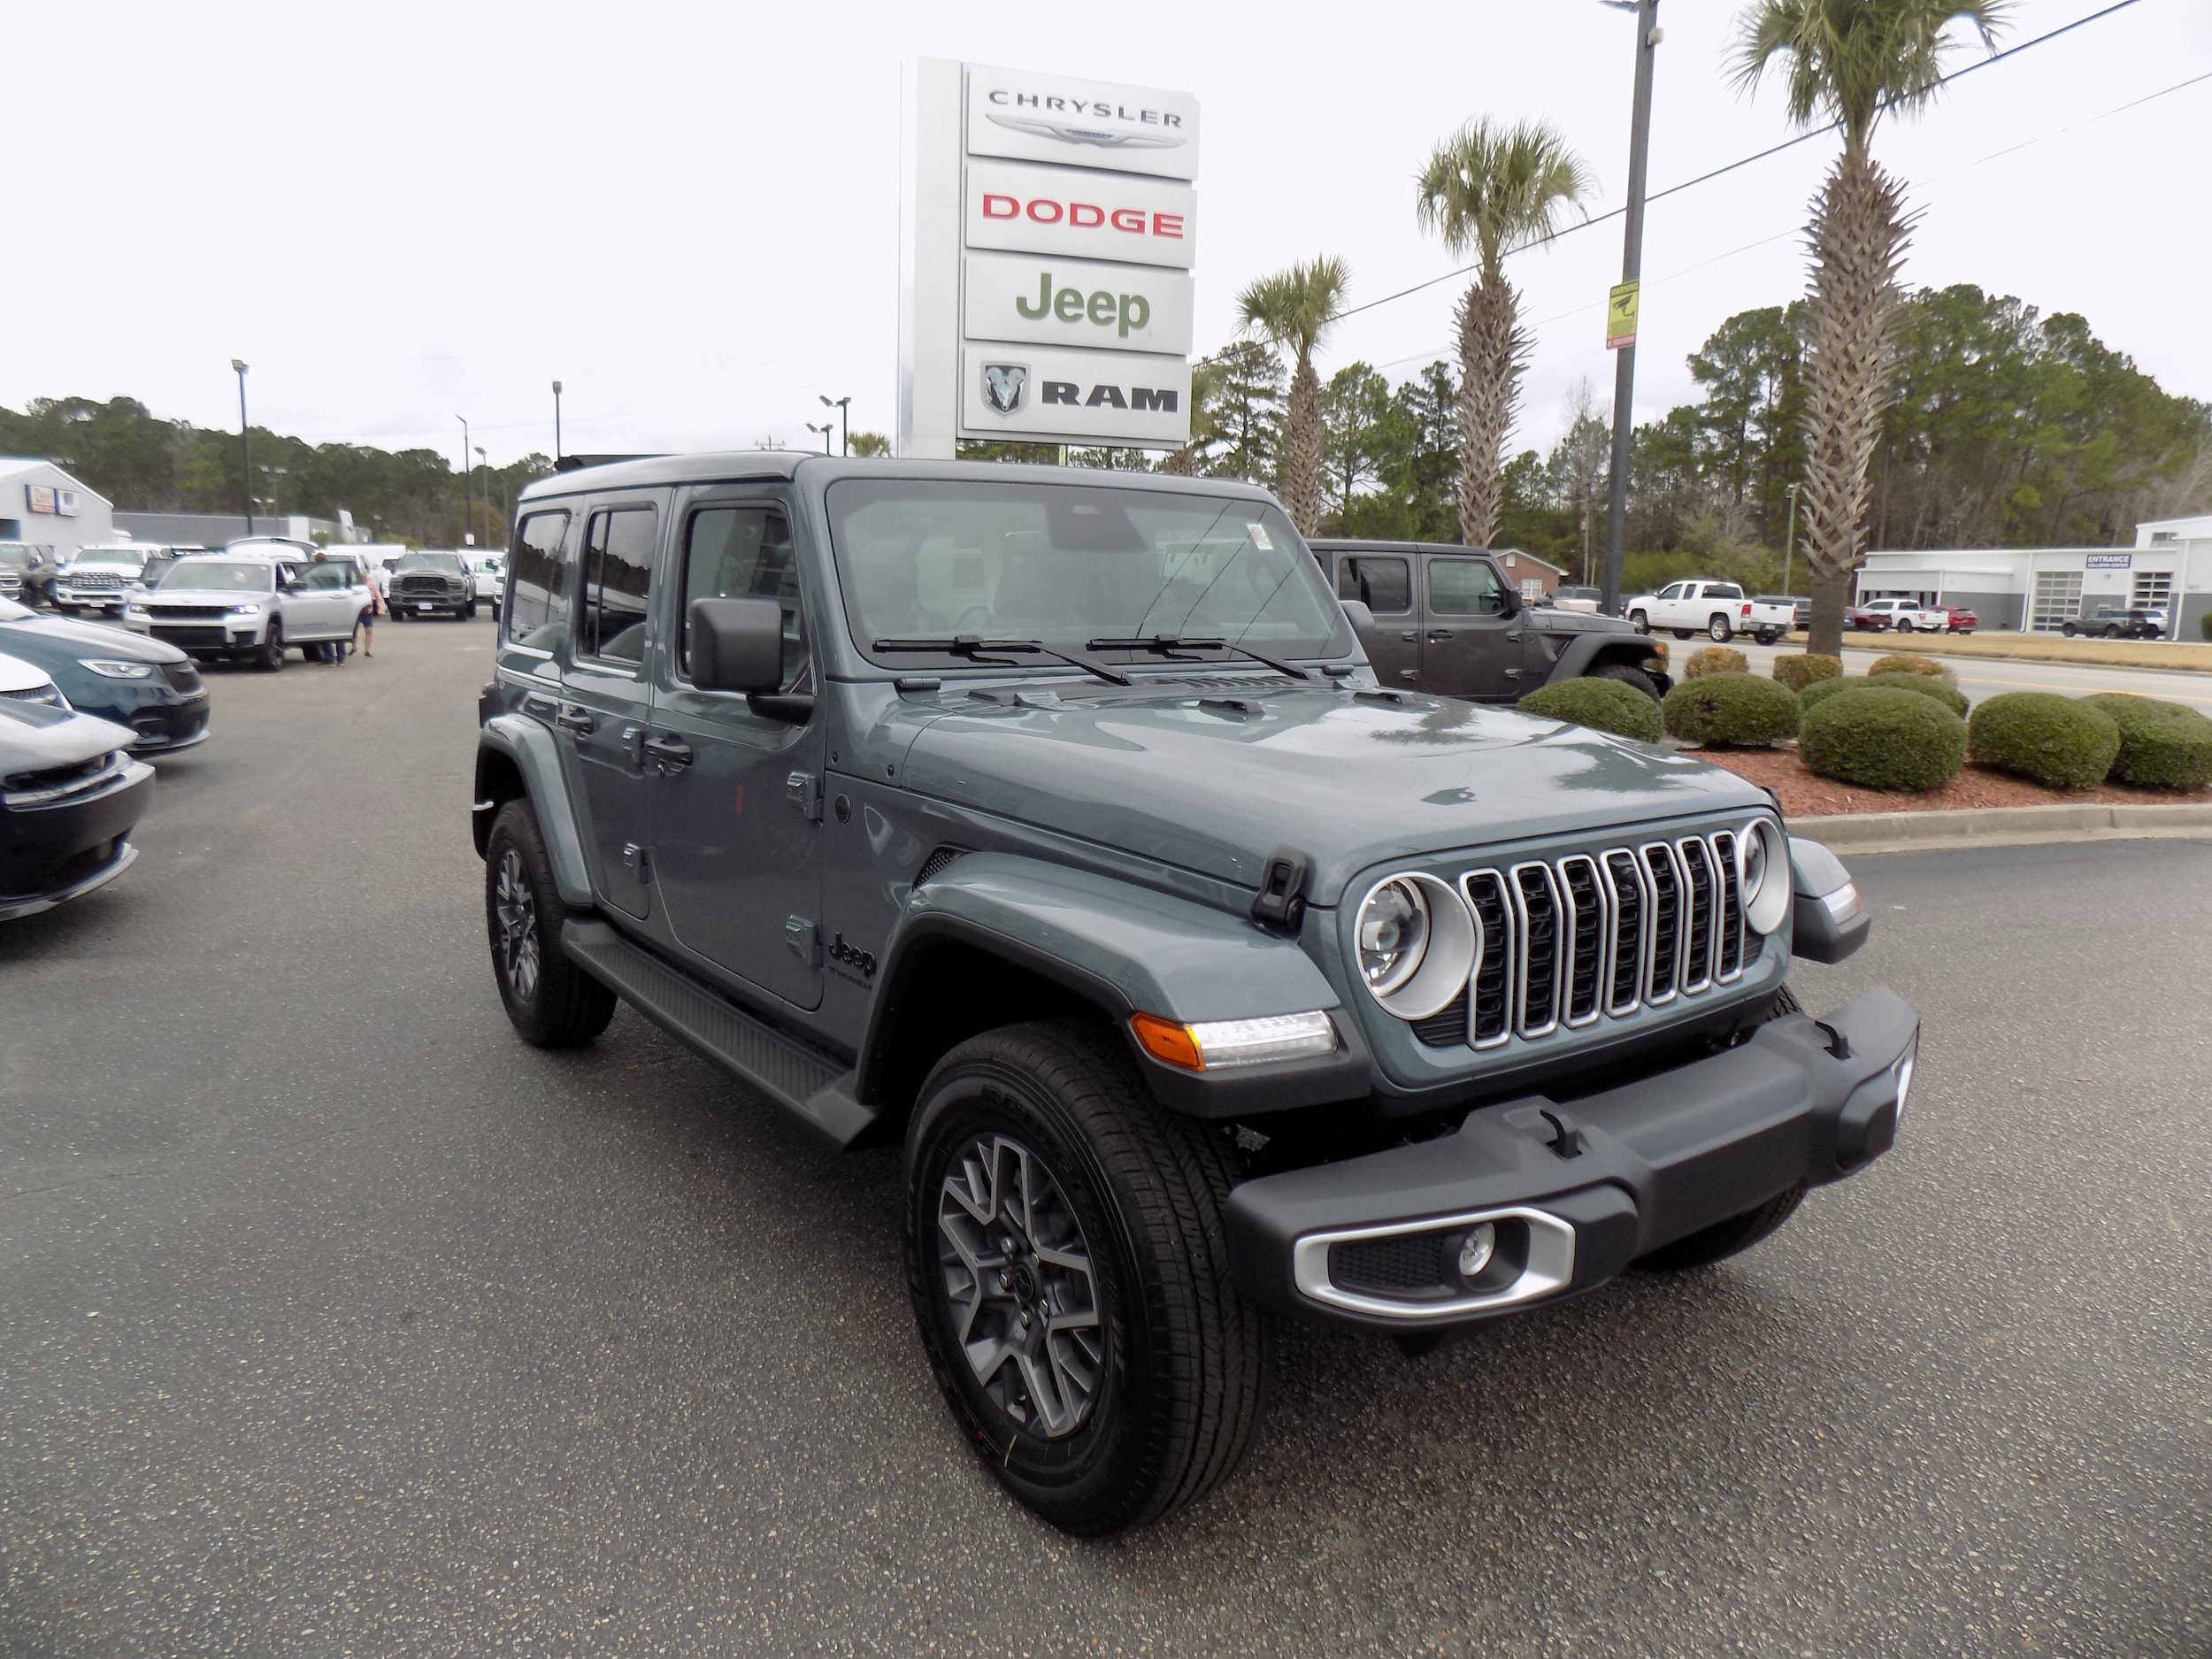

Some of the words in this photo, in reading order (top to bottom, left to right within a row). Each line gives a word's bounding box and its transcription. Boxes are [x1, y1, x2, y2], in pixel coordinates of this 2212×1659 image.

[988, 90, 1182, 128] CHRYSLER
[982, 194, 1184, 239] DODGE
[1016, 273, 1151, 338] Jeep
[1041, 380, 1179, 413] RAM
[828, 932, 877, 979] Jeep
